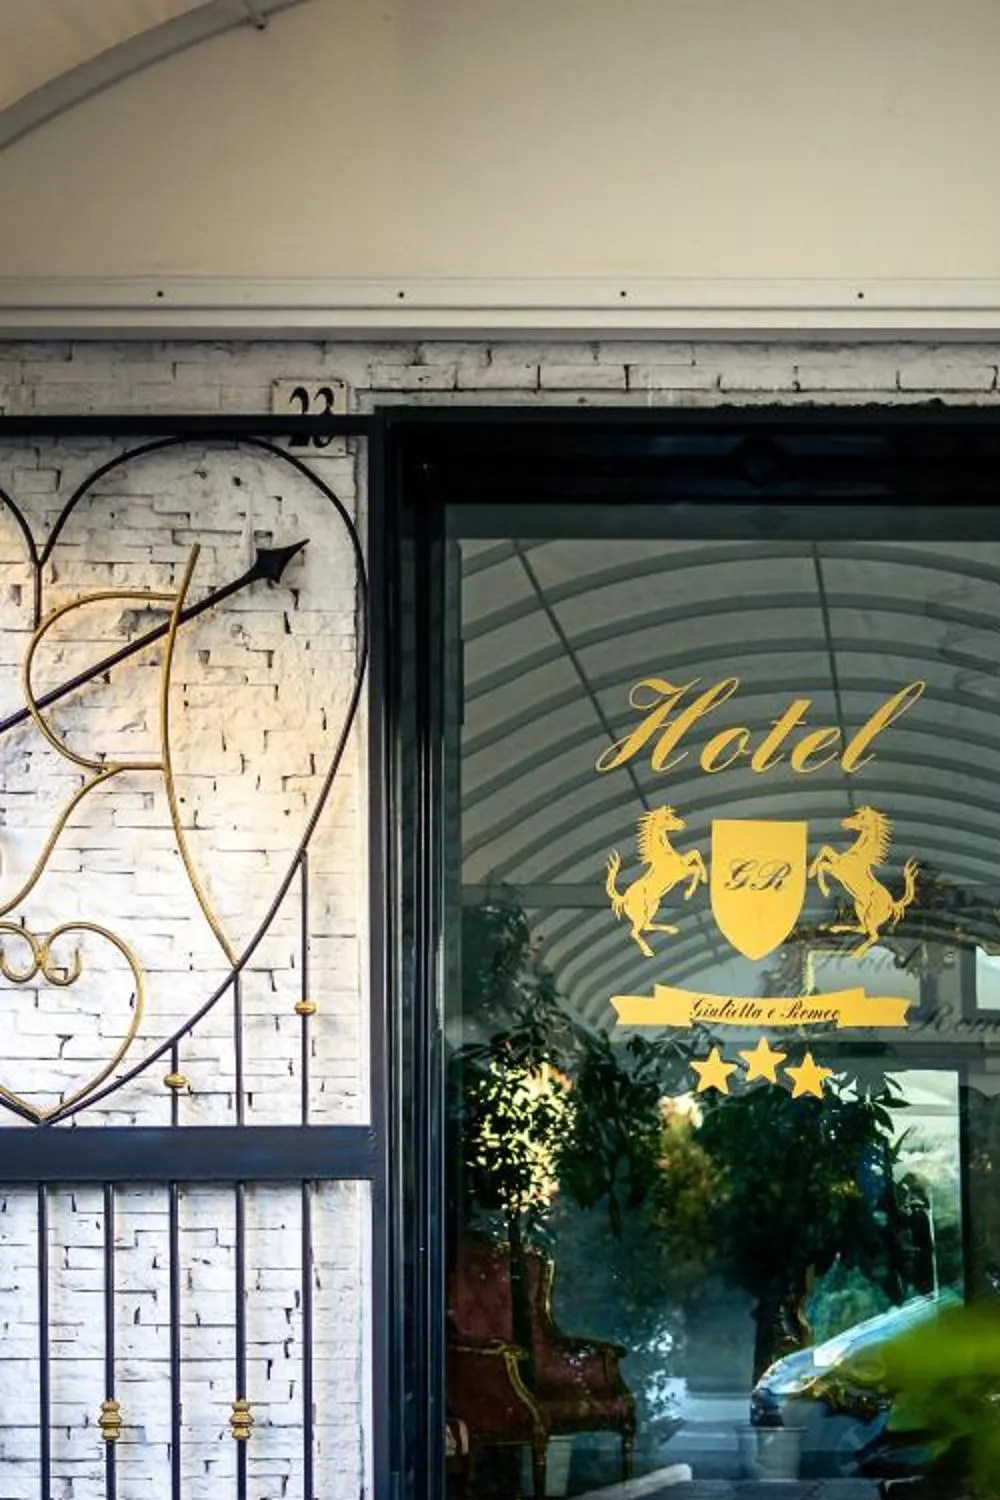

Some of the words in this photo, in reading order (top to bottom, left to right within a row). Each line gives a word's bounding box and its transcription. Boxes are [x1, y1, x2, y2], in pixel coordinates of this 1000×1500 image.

[595, 676, 926, 774] Hotel
[724, 858, 794, 893] GR
[689, 997, 761, 1018] Giulietta
[781, 1000, 841, 1020] Romeo
